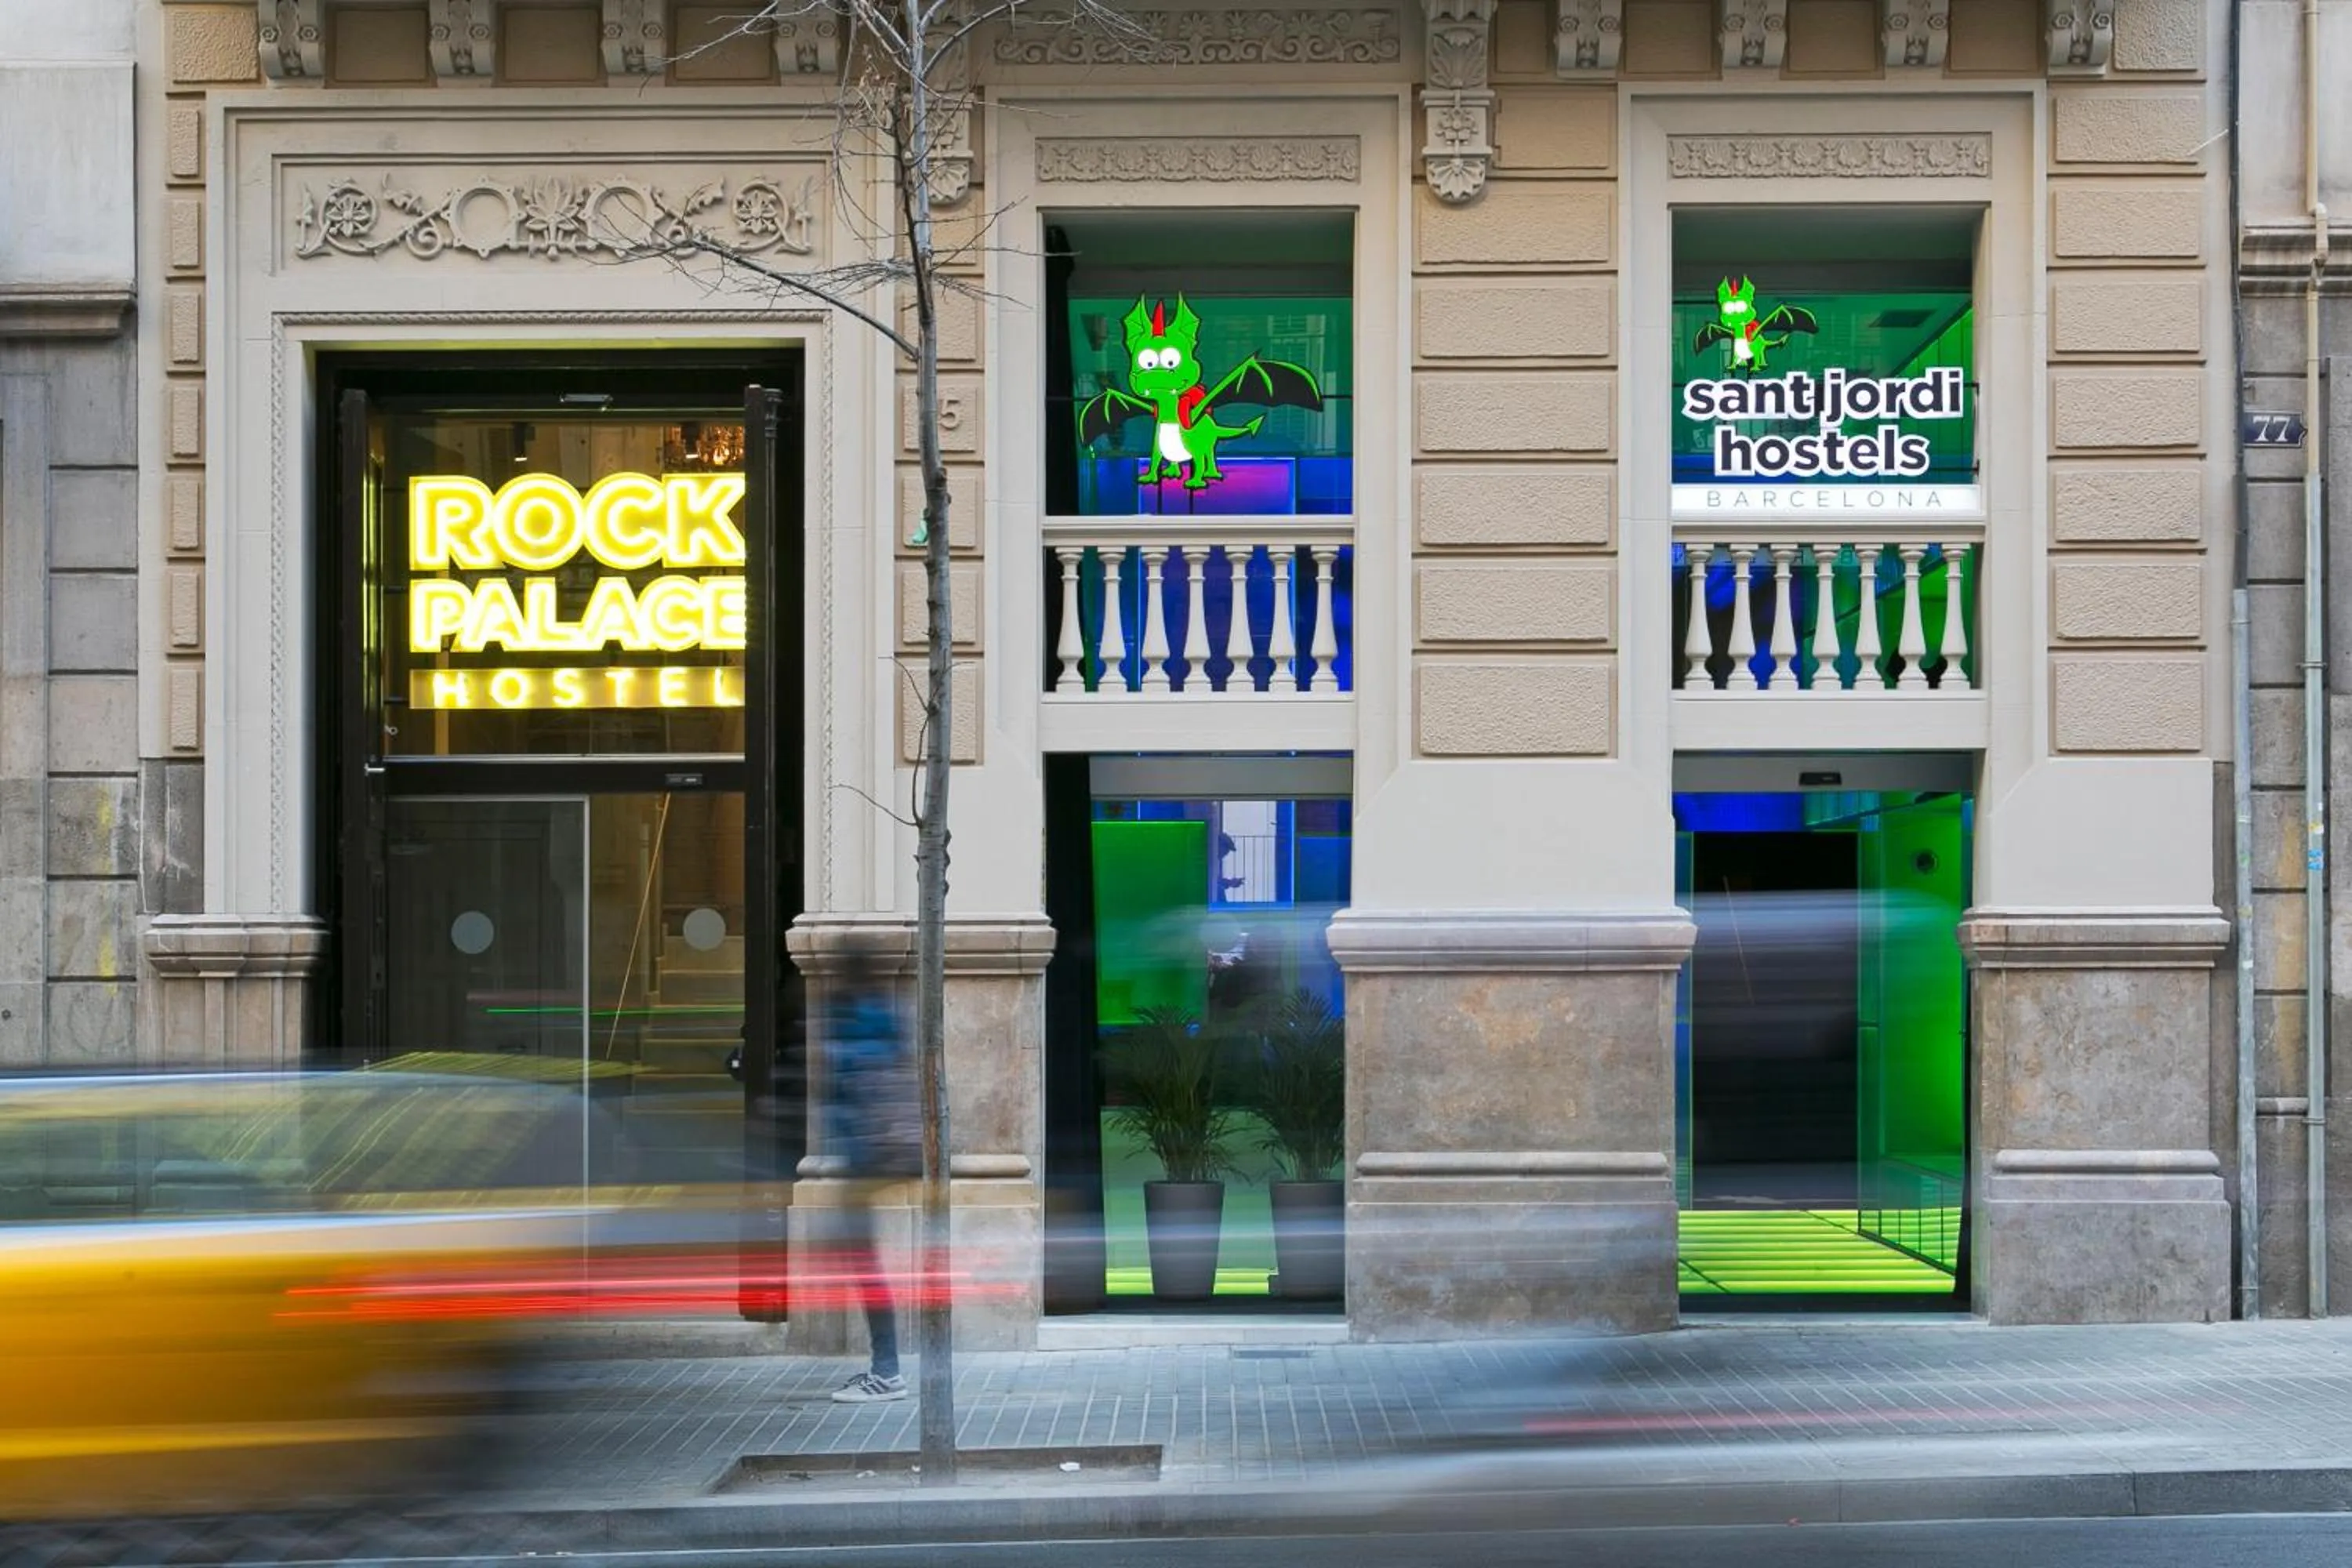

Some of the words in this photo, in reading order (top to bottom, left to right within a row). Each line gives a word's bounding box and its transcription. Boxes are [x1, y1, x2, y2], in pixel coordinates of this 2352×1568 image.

[1686, 373, 1811, 416] sant
[1824, 370, 1962, 423] jordi
[1719, 428, 1928, 471] hostels
[2252, 415, 2291, 442] 77
[1706, 490, 1943, 508] BARCELONA
[409, 472, 745, 570] ROCK
[409, 575, 746, 652] PALACE
[432, 667, 744, 708] HOSTEL
